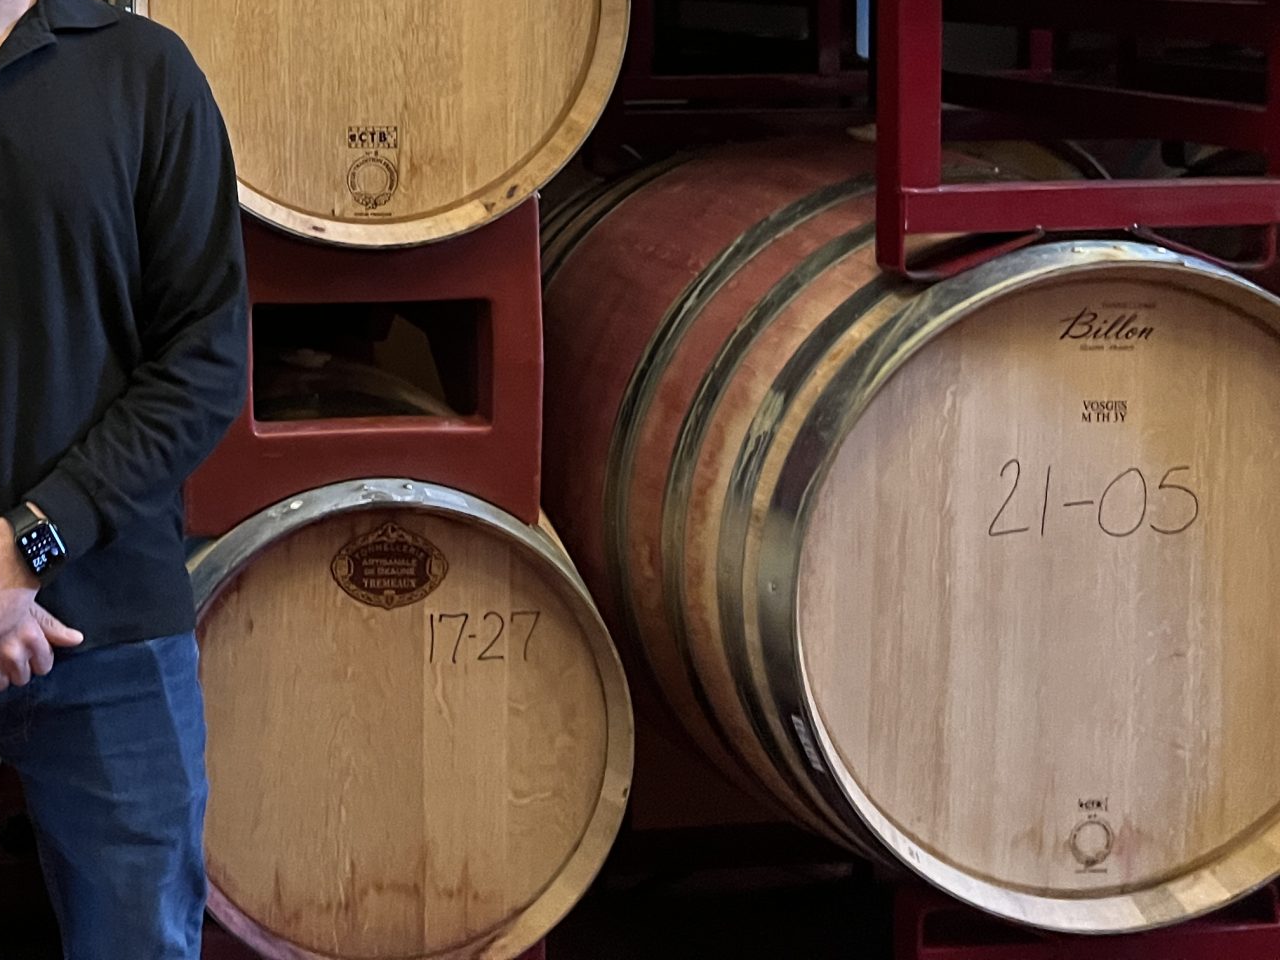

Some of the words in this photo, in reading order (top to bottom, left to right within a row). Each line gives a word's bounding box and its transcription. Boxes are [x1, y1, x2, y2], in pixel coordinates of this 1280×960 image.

[359, 131, 388, 143] CTB
[1059, 306, 1155, 340] Billon
[1081, 411, 1092, 422] M
[988, 458, 1199, 537] 21-05
[428, 610, 541, 665] 17-27
